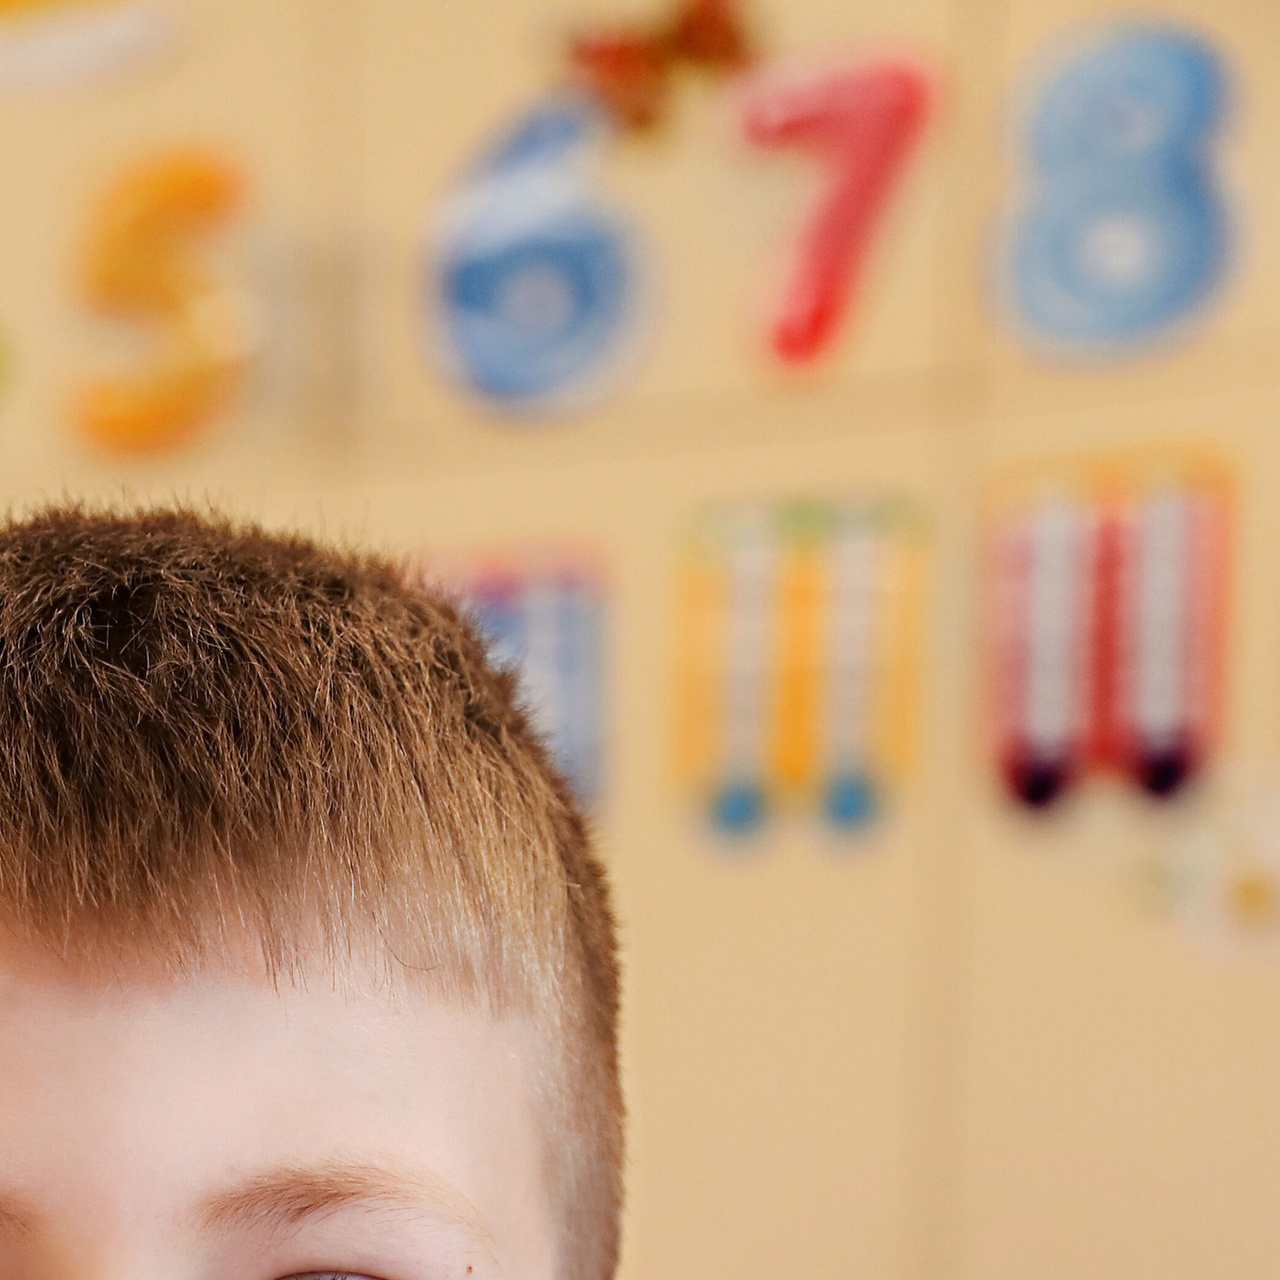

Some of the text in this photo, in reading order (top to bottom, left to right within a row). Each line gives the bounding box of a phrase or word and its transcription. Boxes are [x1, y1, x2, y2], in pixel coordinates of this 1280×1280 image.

[72, 147, 248, 457] 5
[433, 90, 632, 412] 6
[740, 58, 933, 365] 7
[1006, 24, 1233, 352] 8
